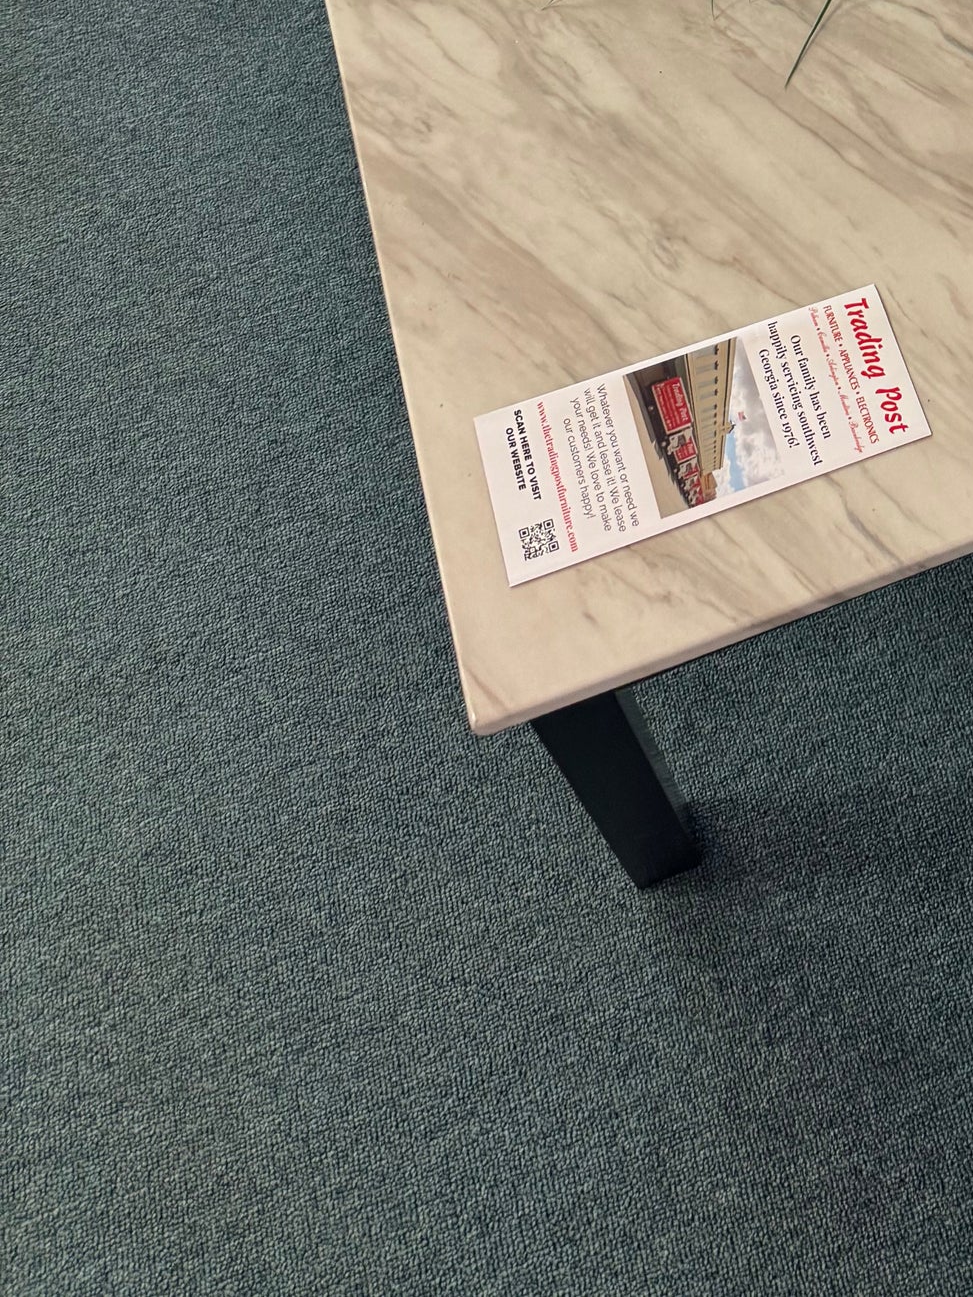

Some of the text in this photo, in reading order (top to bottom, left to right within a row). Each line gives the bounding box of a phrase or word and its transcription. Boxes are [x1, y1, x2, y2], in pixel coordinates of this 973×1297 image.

[584, 388, 595, 405] will
[758, 349, 800, 448] Georgia since 1976!
[767, 321, 823, 465] happily servicing southwest
[790, 335, 831, 439] Our family has been
[823, 305, 879, 443] FURNITURE APPLIANCES ELECTRONICS
[844, 297, 909, 434] Trading Post
[505, 427, 526, 490] OUR WEBSITE
[513, 409, 541, 500] SCAN HERE TO VISIT
[585, 405, 599, 422] get
[594, 430, 607, 449] and
[597, 383, 639, 526] Whatever you want or need we
[537, 401, 578, 552] www.thetradingpostfurniture.com
[563, 418, 596, 518] our customers happy!
[570, 397, 611, 531] your needs! We love to make
[599, 449, 611, 475] lease
[606, 476, 616, 486] it!
[609, 486, 619, 504] We
[613, 504, 626, 532] lease
